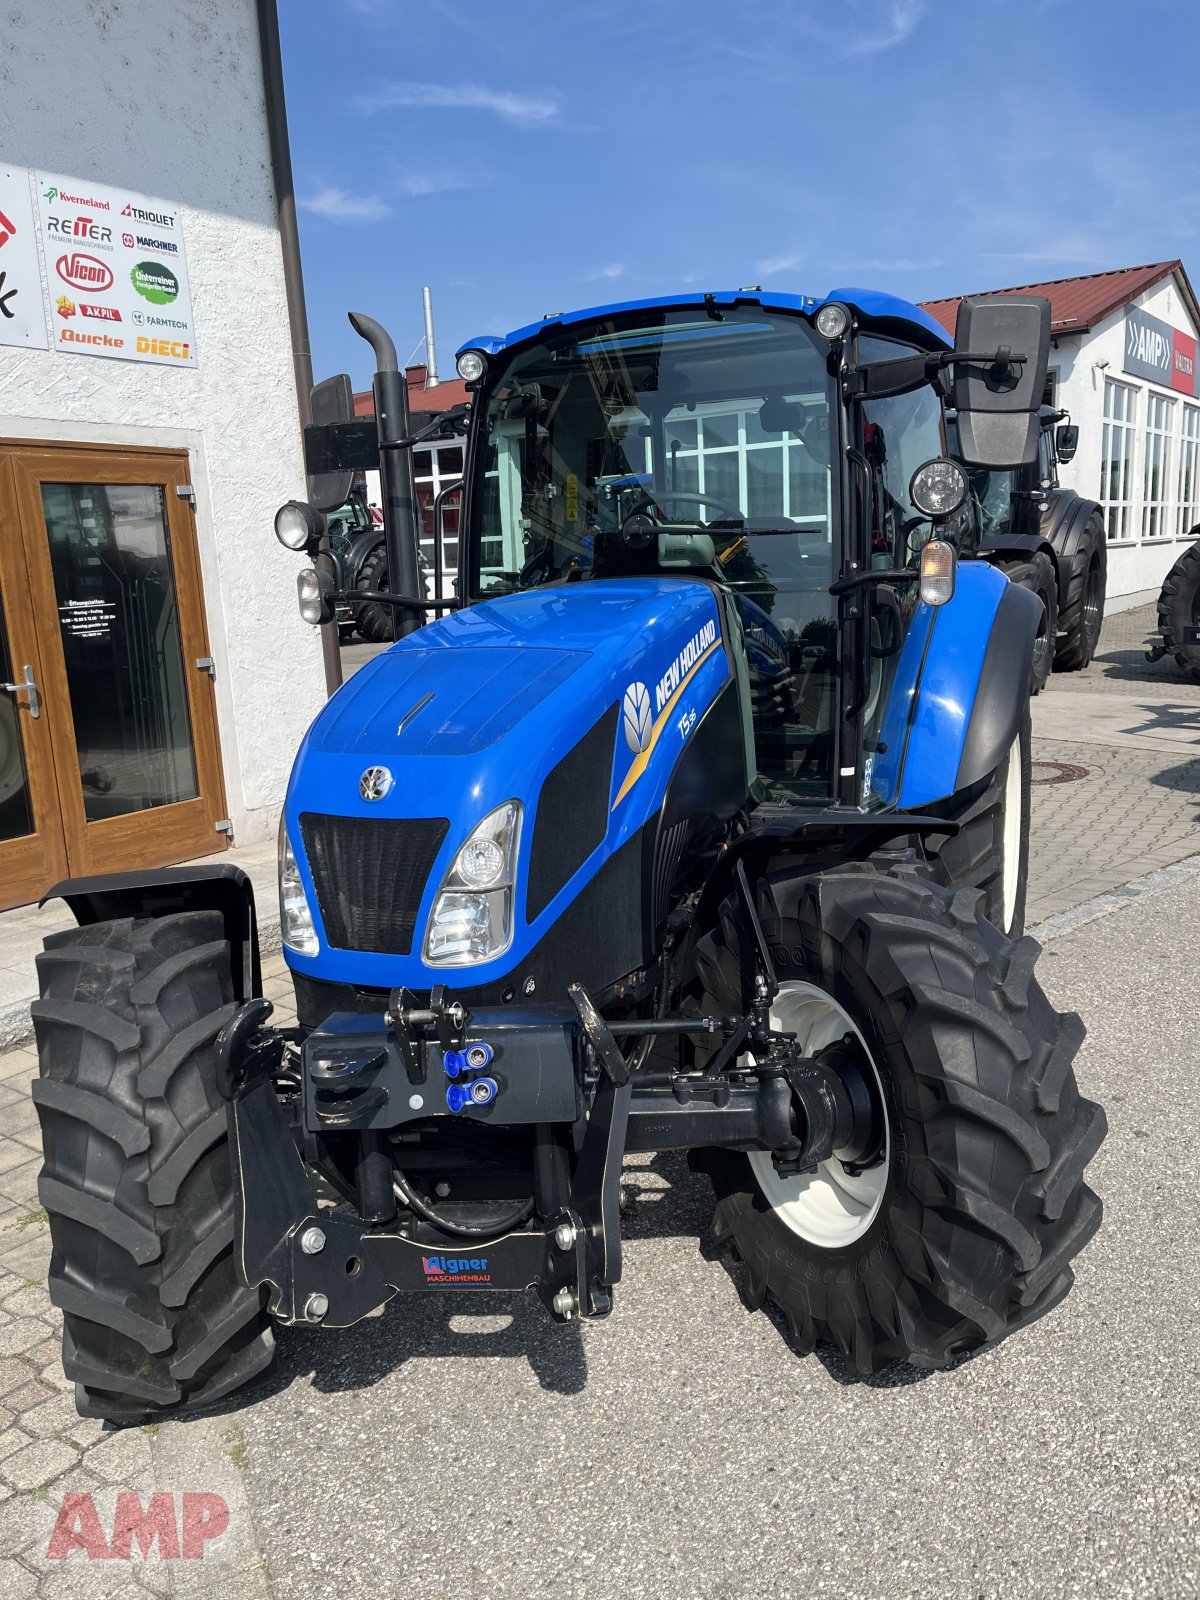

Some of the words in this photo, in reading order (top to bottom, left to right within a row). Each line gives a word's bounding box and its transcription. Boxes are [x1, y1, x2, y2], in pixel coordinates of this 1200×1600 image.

[59, 191, 110, 210] Kverneland
[131, 207, 175, 227] TRIOLIET
[47, 216, 112, 243] REITER
[48, 234, 73, 244] PREMIUM
[136, 235, 178, 253] MARCHNER
[64, 254, 106, 284] Vicon
[135, 271, 175, 287] Unterreiner
[86, 306, 116, 320] AKPIL
[146, 316, 188, 330] FARMTECH
[61, 329, 124, 348] Quicke
[1137, 326, 1162, 367] AMP
[655, 658, 680, 713] NEW
[679, 619, 716, 678] HOLLAND
[427, 1256, 488, 1274] Aigner
